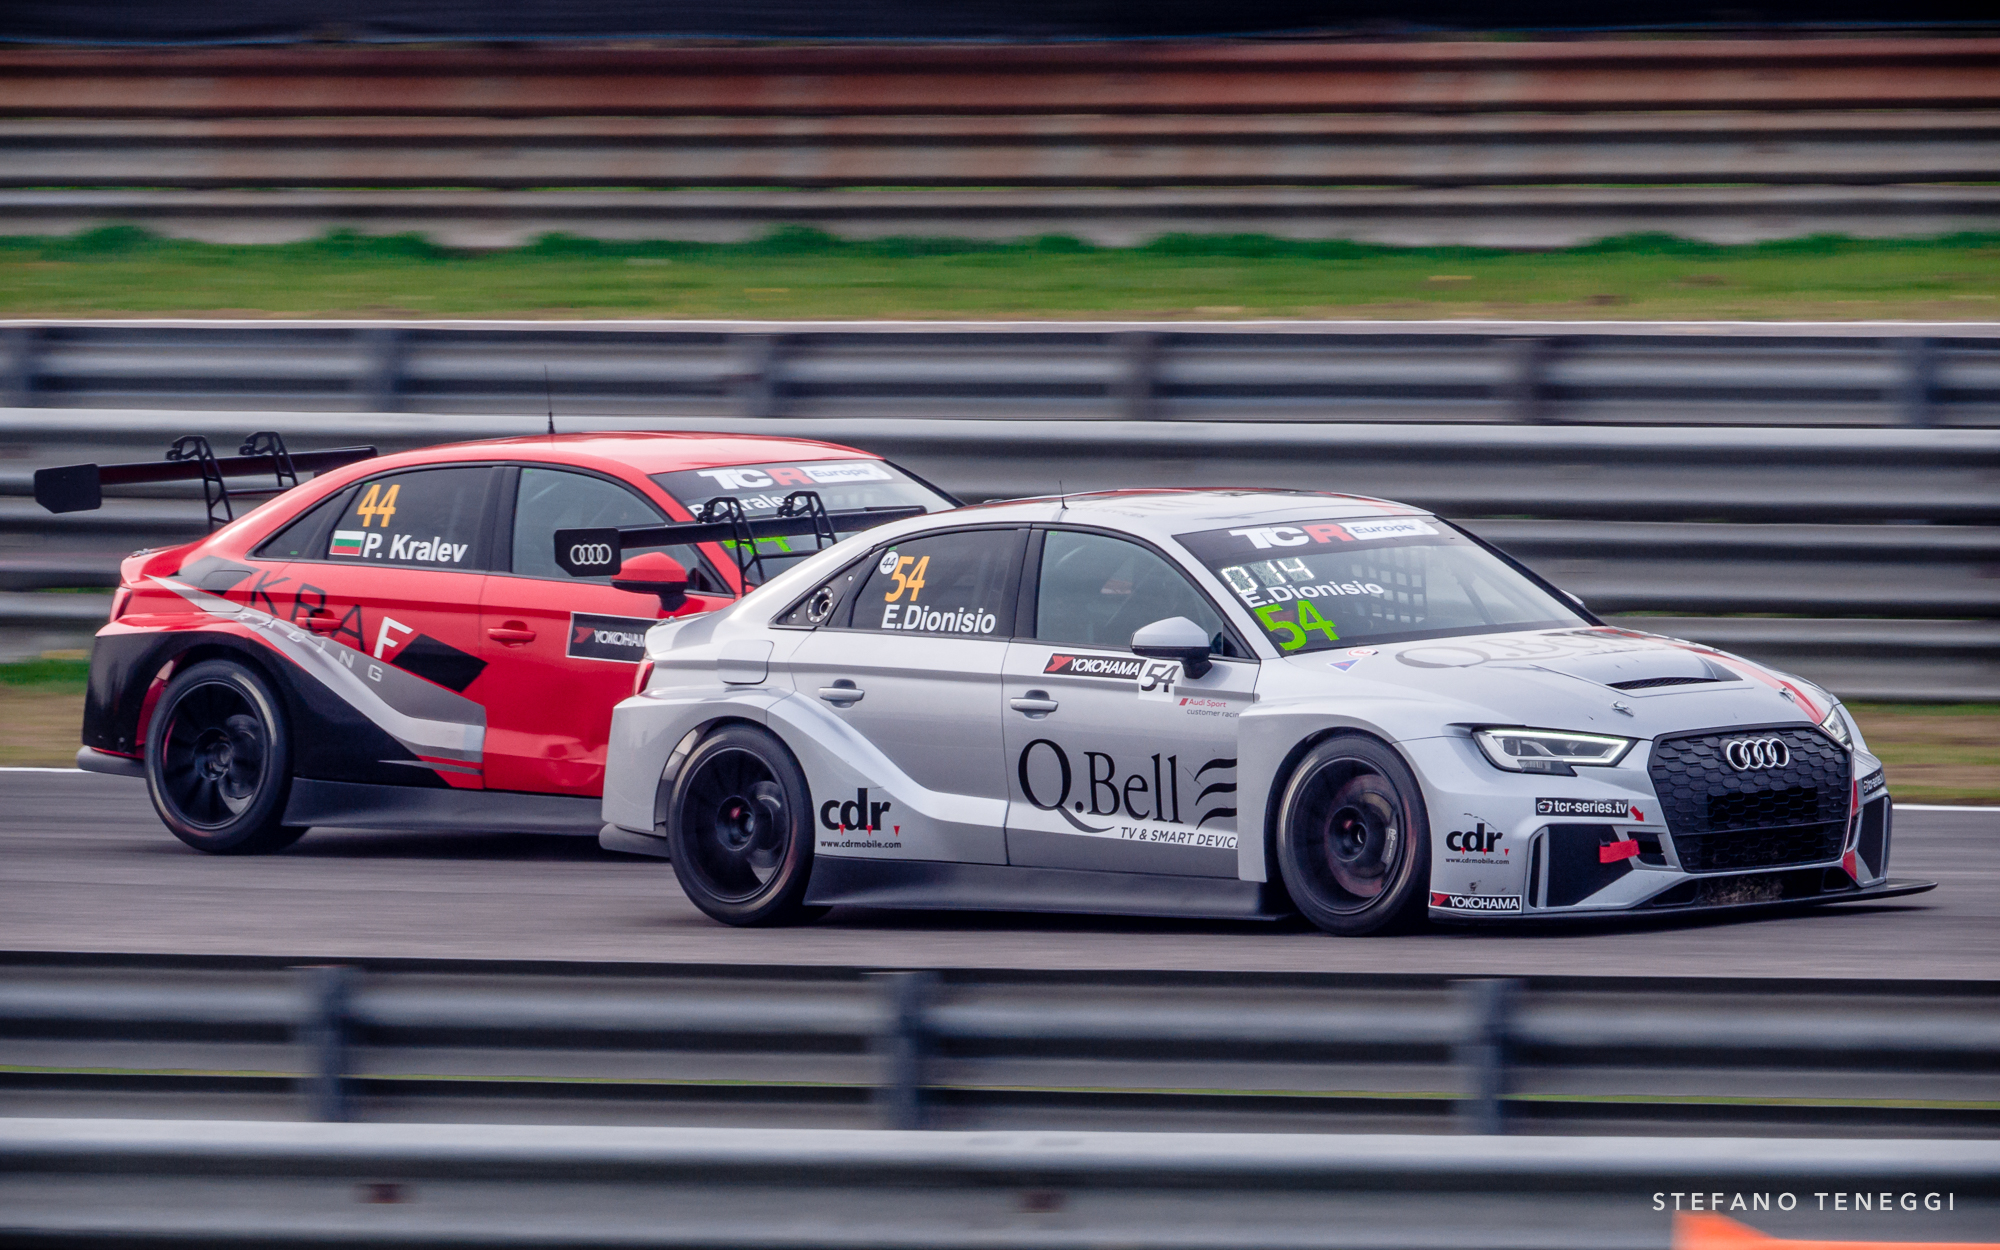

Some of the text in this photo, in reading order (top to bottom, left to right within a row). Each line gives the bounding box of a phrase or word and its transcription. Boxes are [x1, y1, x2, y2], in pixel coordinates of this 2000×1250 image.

[697, 468, 869, 490] TCR Europe
[357, 484, 401, 528] 44
[363, 533, 468, 562] P. Kralev
[1229, 523, 1417, 549] TCR Europe
[882, 556, 897, 569] 44
[884, 556, 930, 603] 54
[1239, 580, 1385, 609] E.Dionisio
[251, 570, 414, 659] KRAF
[881, 604, 996, 634] E.Dionisio
[1254, 599, 1340, 651] 54
[234, 612, 384, 682] RACING
[1070, 658, 1141, 676] YOKOHAMA
[1140, 663, 1180, 693] 54
[1186, 708, 1221, 717] customer
[1188, 698, 1227, 708] Audi Sport
[1018, 738, 1184, 833] Q.Bell
[820, 787, 891, 831] cdr
[1554, 800, 1627, 814] tcr-series.tv
[820, 840, 902, 849] www.cdrmobile.com
[1121, 826, 1239, 849] TV & SMART DEVIC
[1446, 822, 1503, 853] cdr
[1445, 857, 1510, 865] www.cdrmobile.com
[1450, 895, 1519, 909] YOKOHAMA
